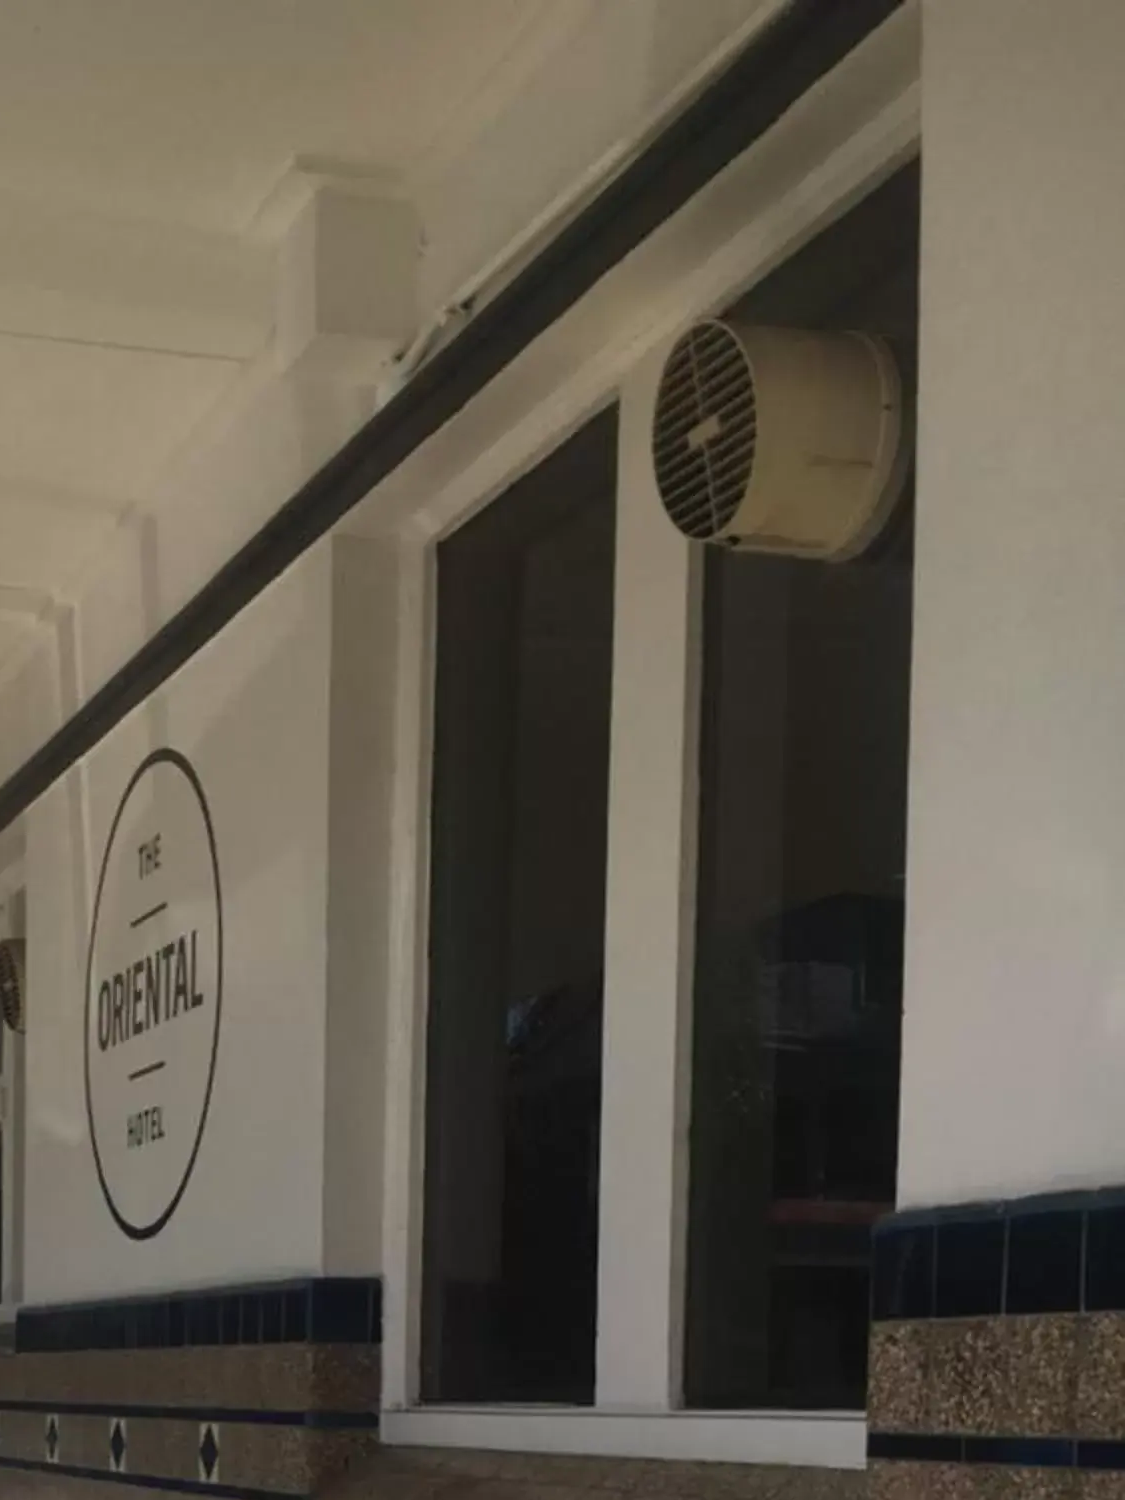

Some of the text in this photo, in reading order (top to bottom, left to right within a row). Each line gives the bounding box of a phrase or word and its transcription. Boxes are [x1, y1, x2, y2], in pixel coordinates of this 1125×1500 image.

[137, 832, 162, 880] THE
[97, 929, 204, 1052] ORIENTAL
[126, 1106, 166, 1148] HOTEL
